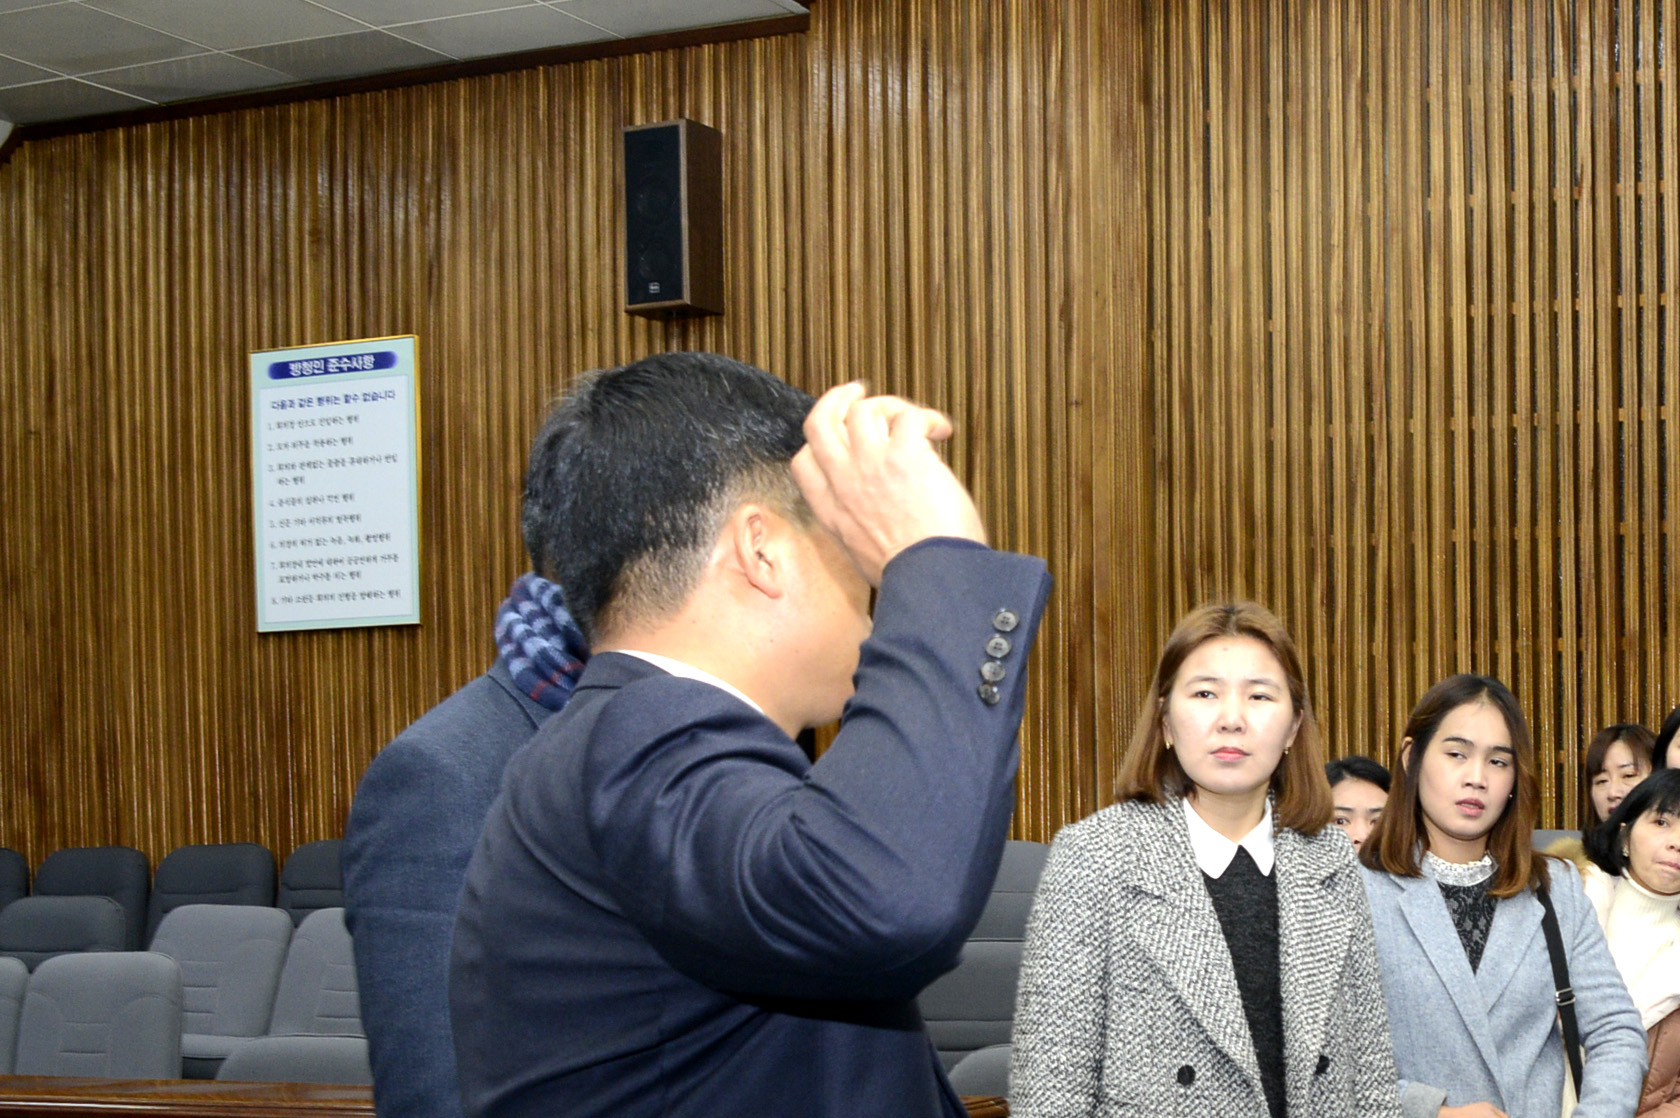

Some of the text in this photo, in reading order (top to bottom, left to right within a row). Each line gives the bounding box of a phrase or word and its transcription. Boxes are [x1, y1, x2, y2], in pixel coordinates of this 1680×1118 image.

[289, 354, 375, 376] 방청인 준수사항
[271, 399, 295, 410] 다음과
[298, 397, 314, 408] 같은
[316, 395, 341, 407] 행위는
[362, 390, 396, 402] 없습니다
